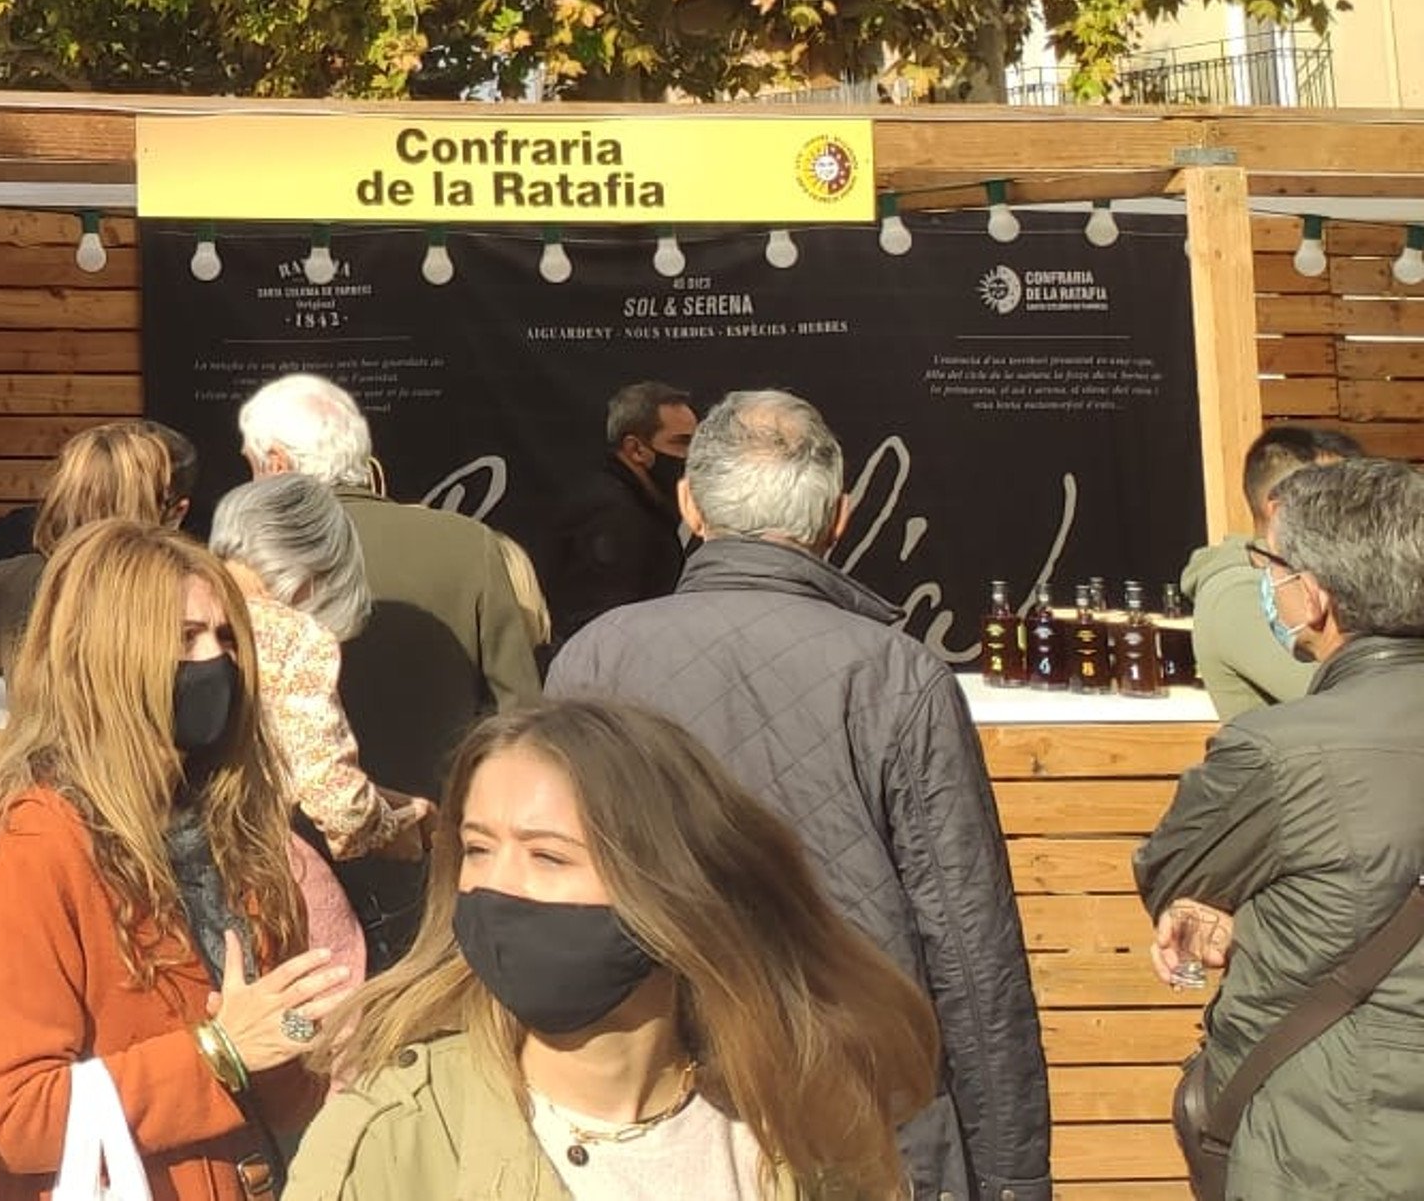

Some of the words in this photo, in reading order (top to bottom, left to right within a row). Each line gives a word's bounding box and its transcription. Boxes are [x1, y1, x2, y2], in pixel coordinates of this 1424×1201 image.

[395, 127, 624, 166] Confraria
[356, 171, 414, 206] de
[433, 171, 476, 206] la
[493, 171, 666, 208] Ratafia
[1025, 270, 1094, 285] CONFRARIA
[1026, 286, 1040, 301] DE
[1043, 286, 1058, 301] LA
[1060, 286, 1108, 302] RATAFIA
[623, 297, 657, 317] SOL
[664, 297, 677, 315] &
[682, 294, 753, 316] SERENA
[526, 327, 613, 340] AIGUARDENT
